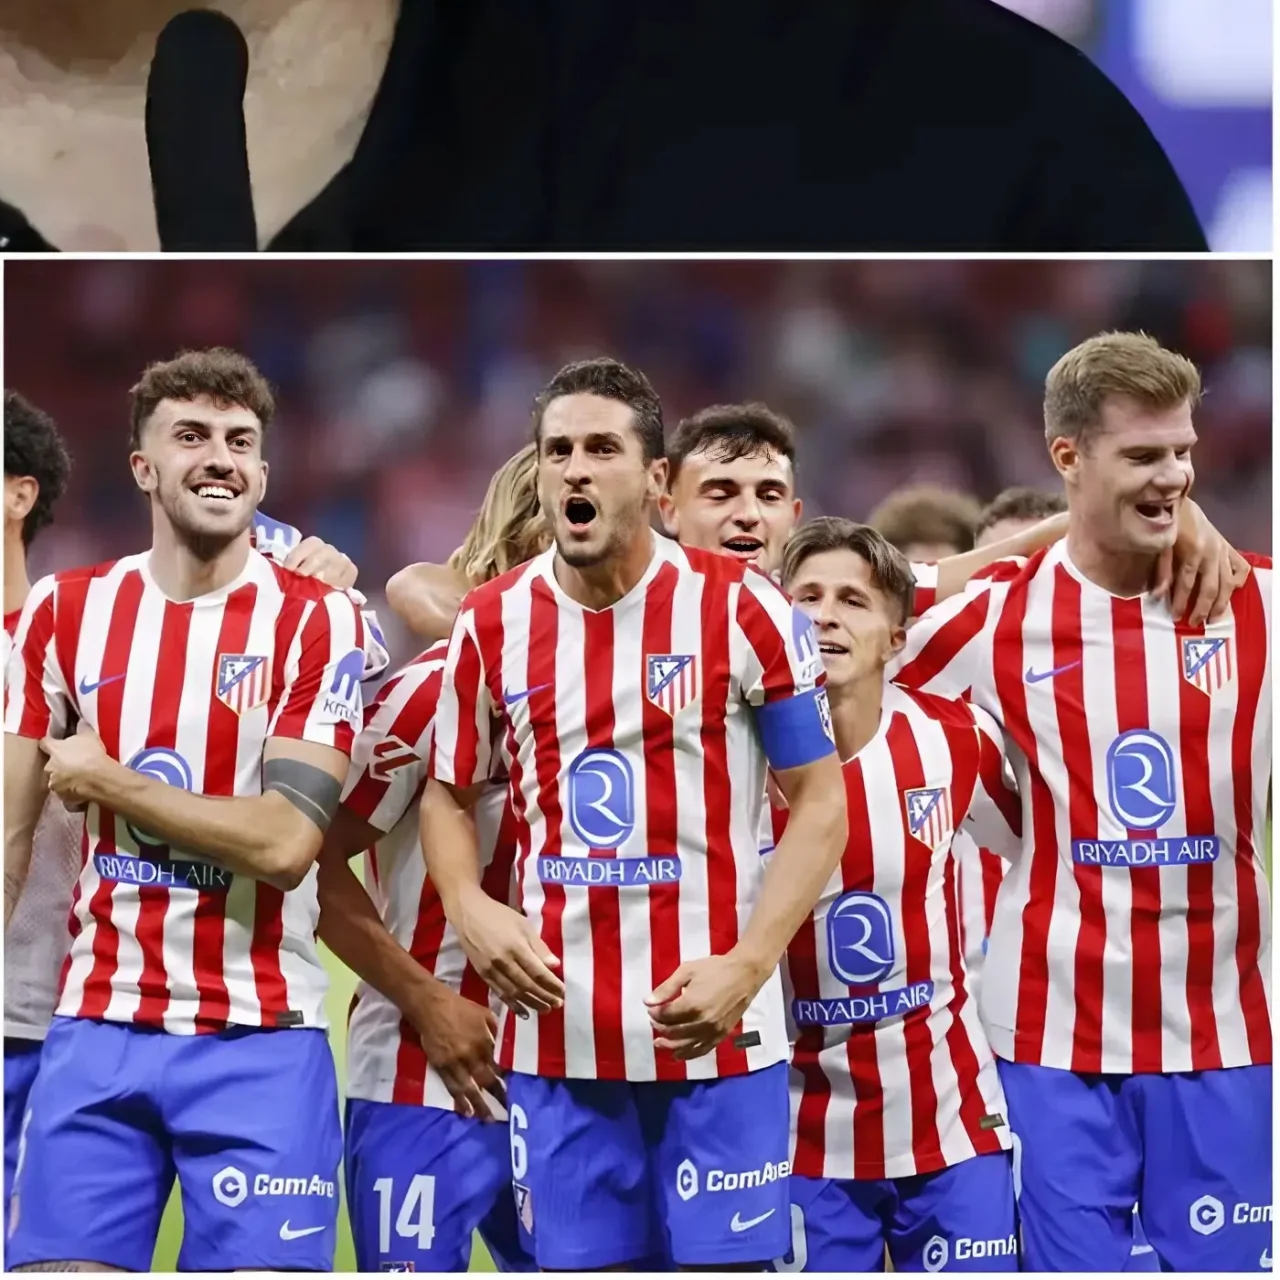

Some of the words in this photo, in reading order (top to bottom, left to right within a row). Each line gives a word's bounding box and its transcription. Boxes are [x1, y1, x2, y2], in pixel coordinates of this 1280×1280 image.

[1078, 841, 1169, 864] RIYADH
[1177, 839, 1215, 861] AIR
[99, 856, 175, 884] RIYADH
[185, 864, 226, 886] AIR
[542, 859, 625, 883] RIYADH
[633, 859, 677, 881] AIR
[798, 995, 888, 1021] RIYADH
[895, 983, 930, 1012] AIR
[510, 1103, 528, 1180] 6
[373, 1174, 436, 1253] 14
